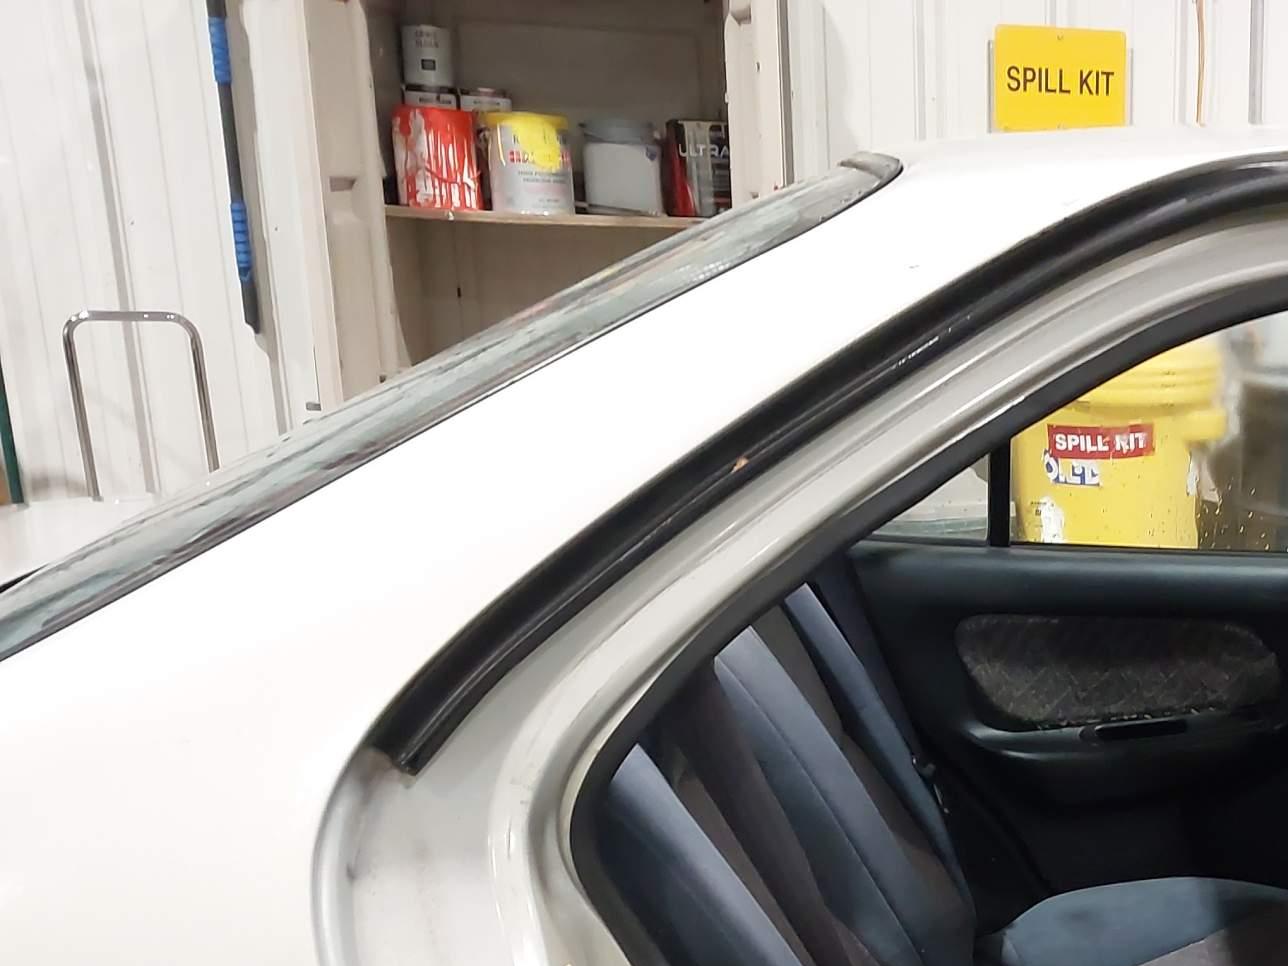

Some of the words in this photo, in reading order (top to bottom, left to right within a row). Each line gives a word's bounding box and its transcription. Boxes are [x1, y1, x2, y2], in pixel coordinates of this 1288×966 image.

[1006, 65, 1071, 95] SPILL
[1079, 69, 1115, 96] KIT
[1055, 433, 1109, 453] SPILL
[1114, 432, 1148, 454] KIT
